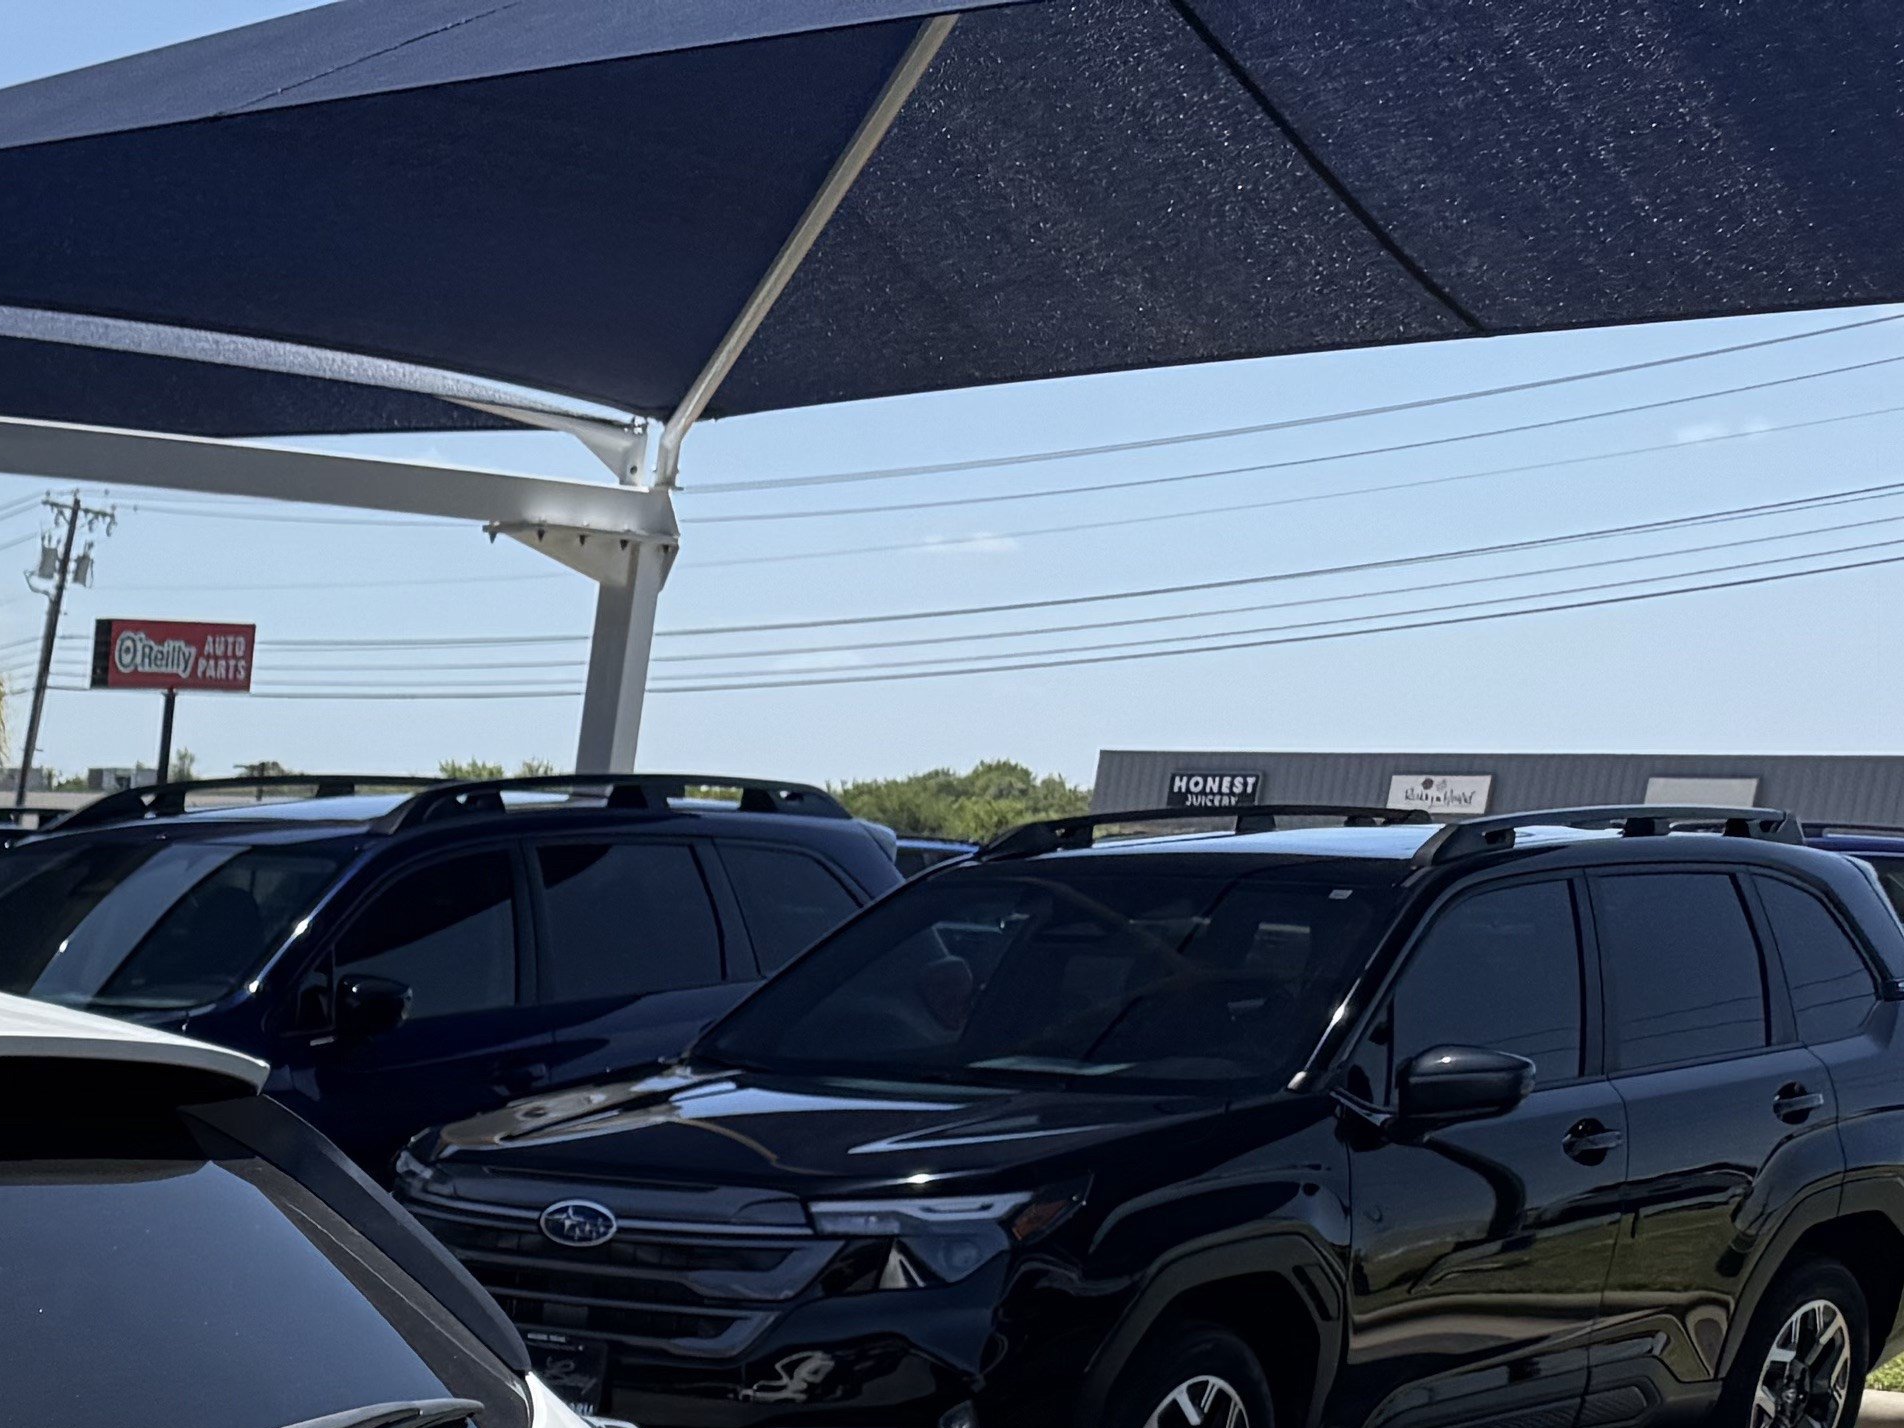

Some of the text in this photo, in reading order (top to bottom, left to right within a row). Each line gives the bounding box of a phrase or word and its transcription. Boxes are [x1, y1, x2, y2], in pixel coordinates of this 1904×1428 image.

[116, 632, 194, 677] O'Reilly
[204, 635, 246, 657] AUTO
[197, 657, 247, 680] PARTS
[1173, 776, 1256, 794] HONEST
